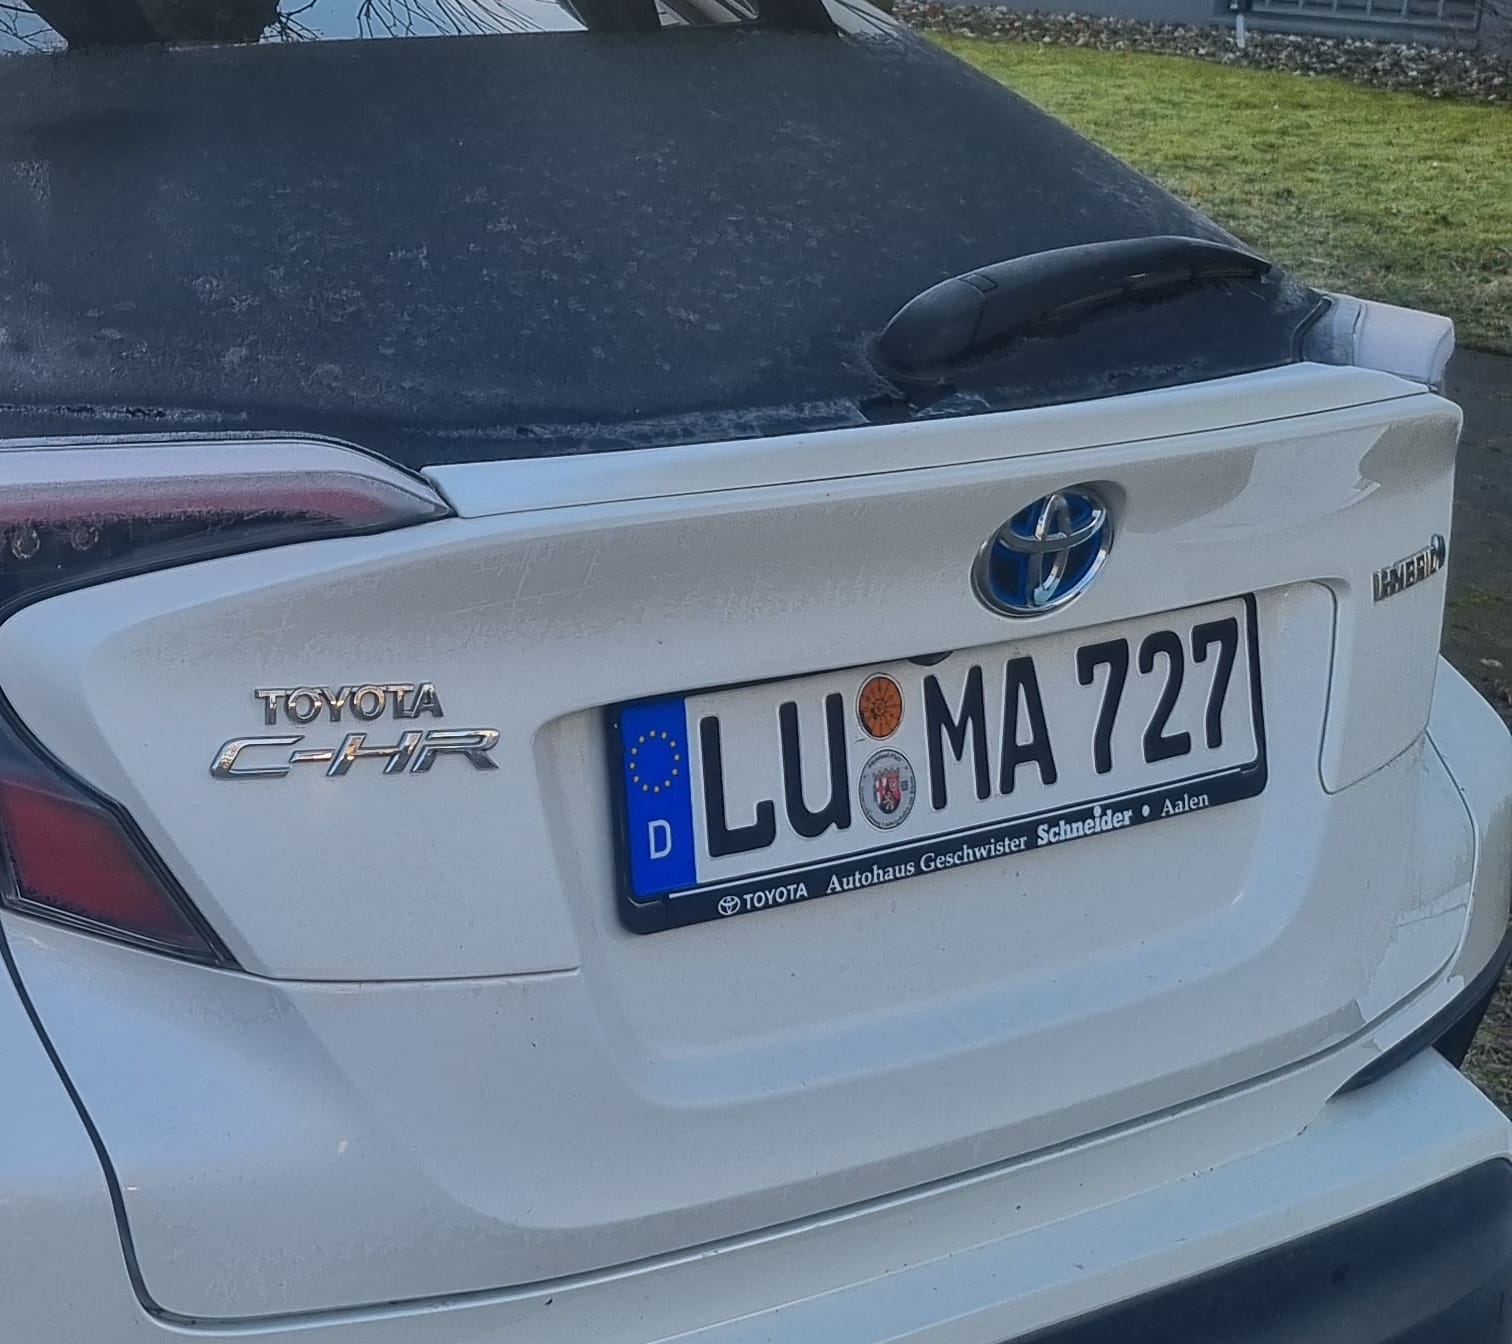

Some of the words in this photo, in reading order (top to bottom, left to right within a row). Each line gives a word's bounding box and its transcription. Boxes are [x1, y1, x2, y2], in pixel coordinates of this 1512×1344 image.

[254, 680, 444, 726] TOYOTA
[209, 727, 501, 778] C-HR
[699, 692, 852, 858] LU
[922, 655, 1058, 811] MA
[1075, 616, 1239, 775] 727
[647, 818, 673, 860] D
[743, 882, 809, 911] TOYOTA
[825, 860, 916, 894] Autohaus
[919, 833, 1028, 873] Geschwister
[1036, 806, 1134, 847] Schneider
[1160, 791, 1210, 817] Aalen
